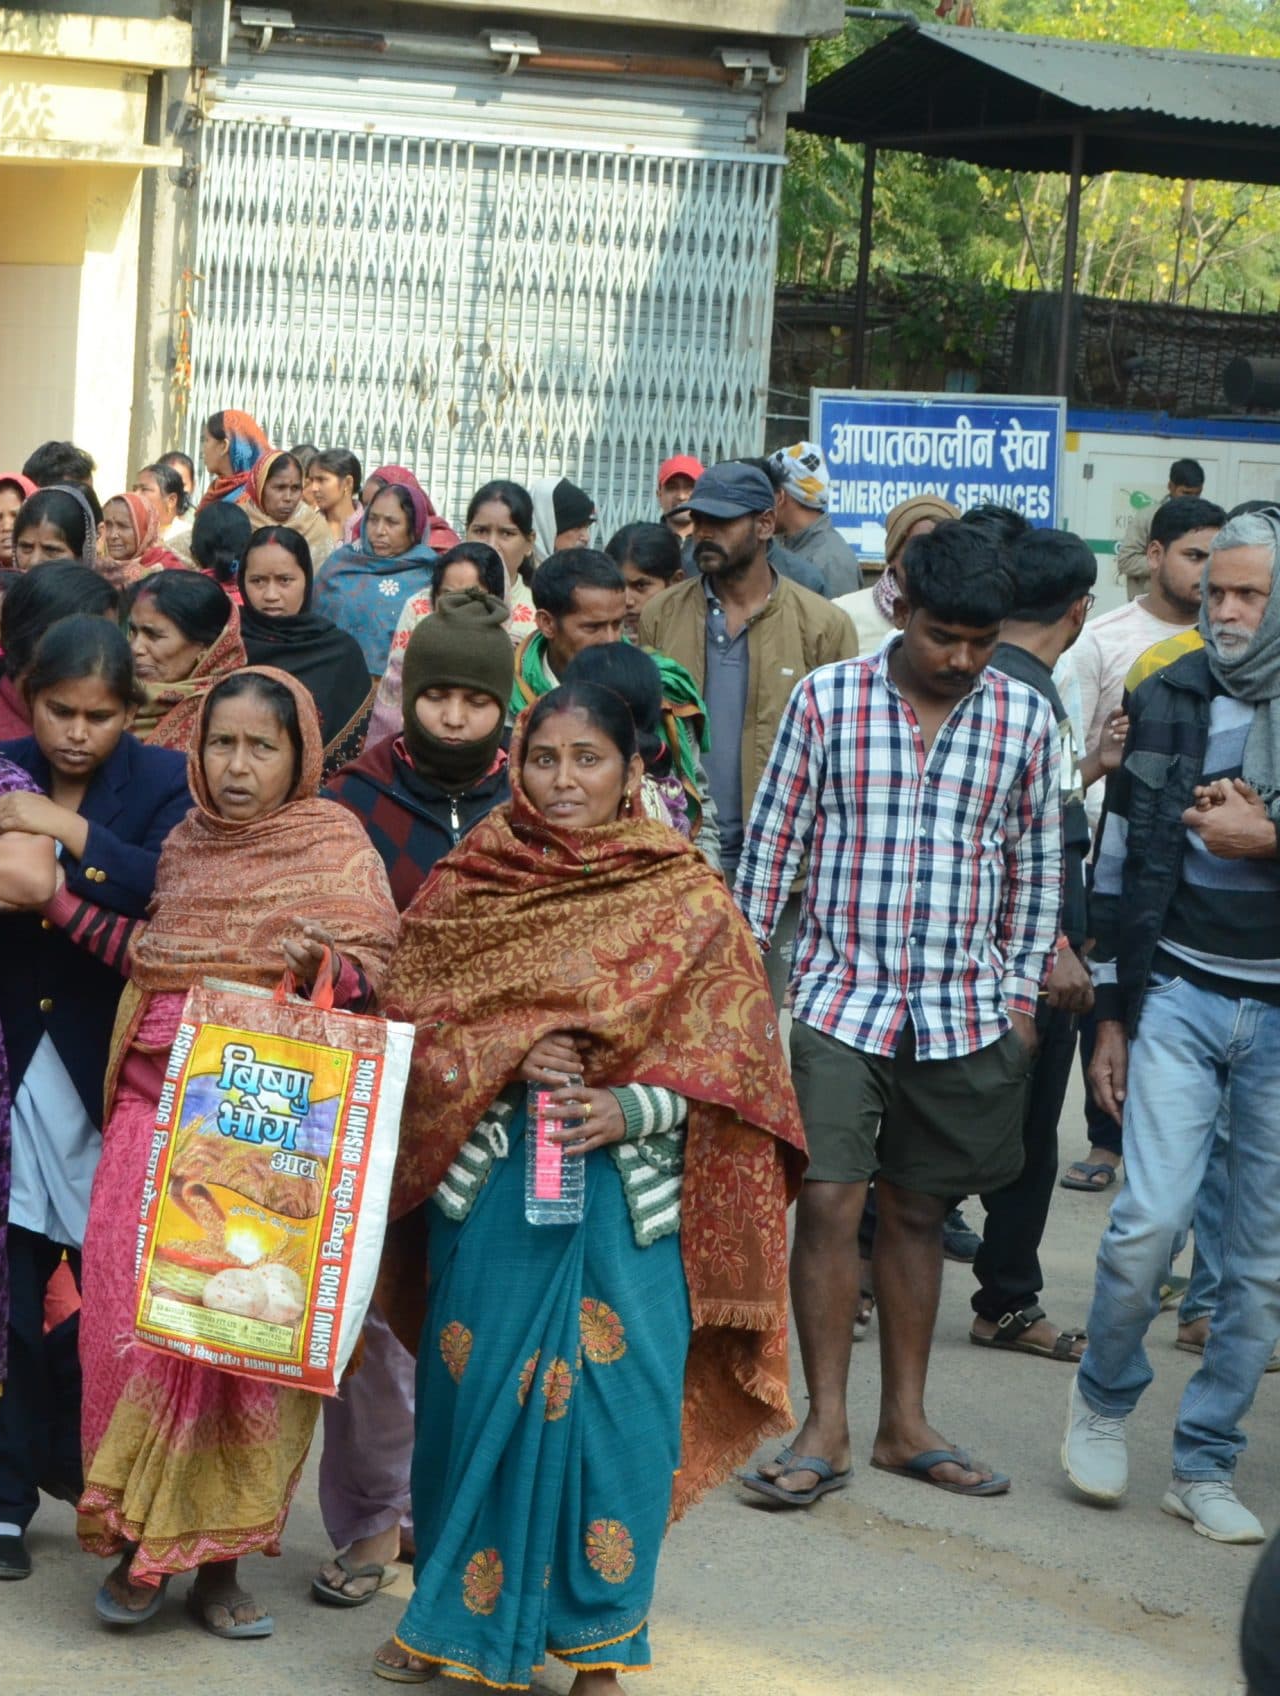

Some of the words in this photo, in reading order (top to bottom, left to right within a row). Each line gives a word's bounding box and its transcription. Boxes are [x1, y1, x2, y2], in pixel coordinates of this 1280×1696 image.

[828, 414, 996, 470] आपातकालीन
[1001, 416, 1051, 473] सेवा
[165, 1023, 197, 1080] BISHNU
[154, 1081, 176, 1125] BHOG
[352, 1058, 377, 1104] BHOG
[218, 1095, 302, 1150] भोग
[341, 1104, 370, 1165] BISHNU
[332, 1167, 358, 1209] भोग
[315, 1264, 343, 1309] BHOG
[167, 1339, 192, 1356] BHOG
[243, 1356, 277, 1372] BISHNU
[277, 1363, 303, 1378] BHOG
[309, 1311, 337, 1369] BISHNU
